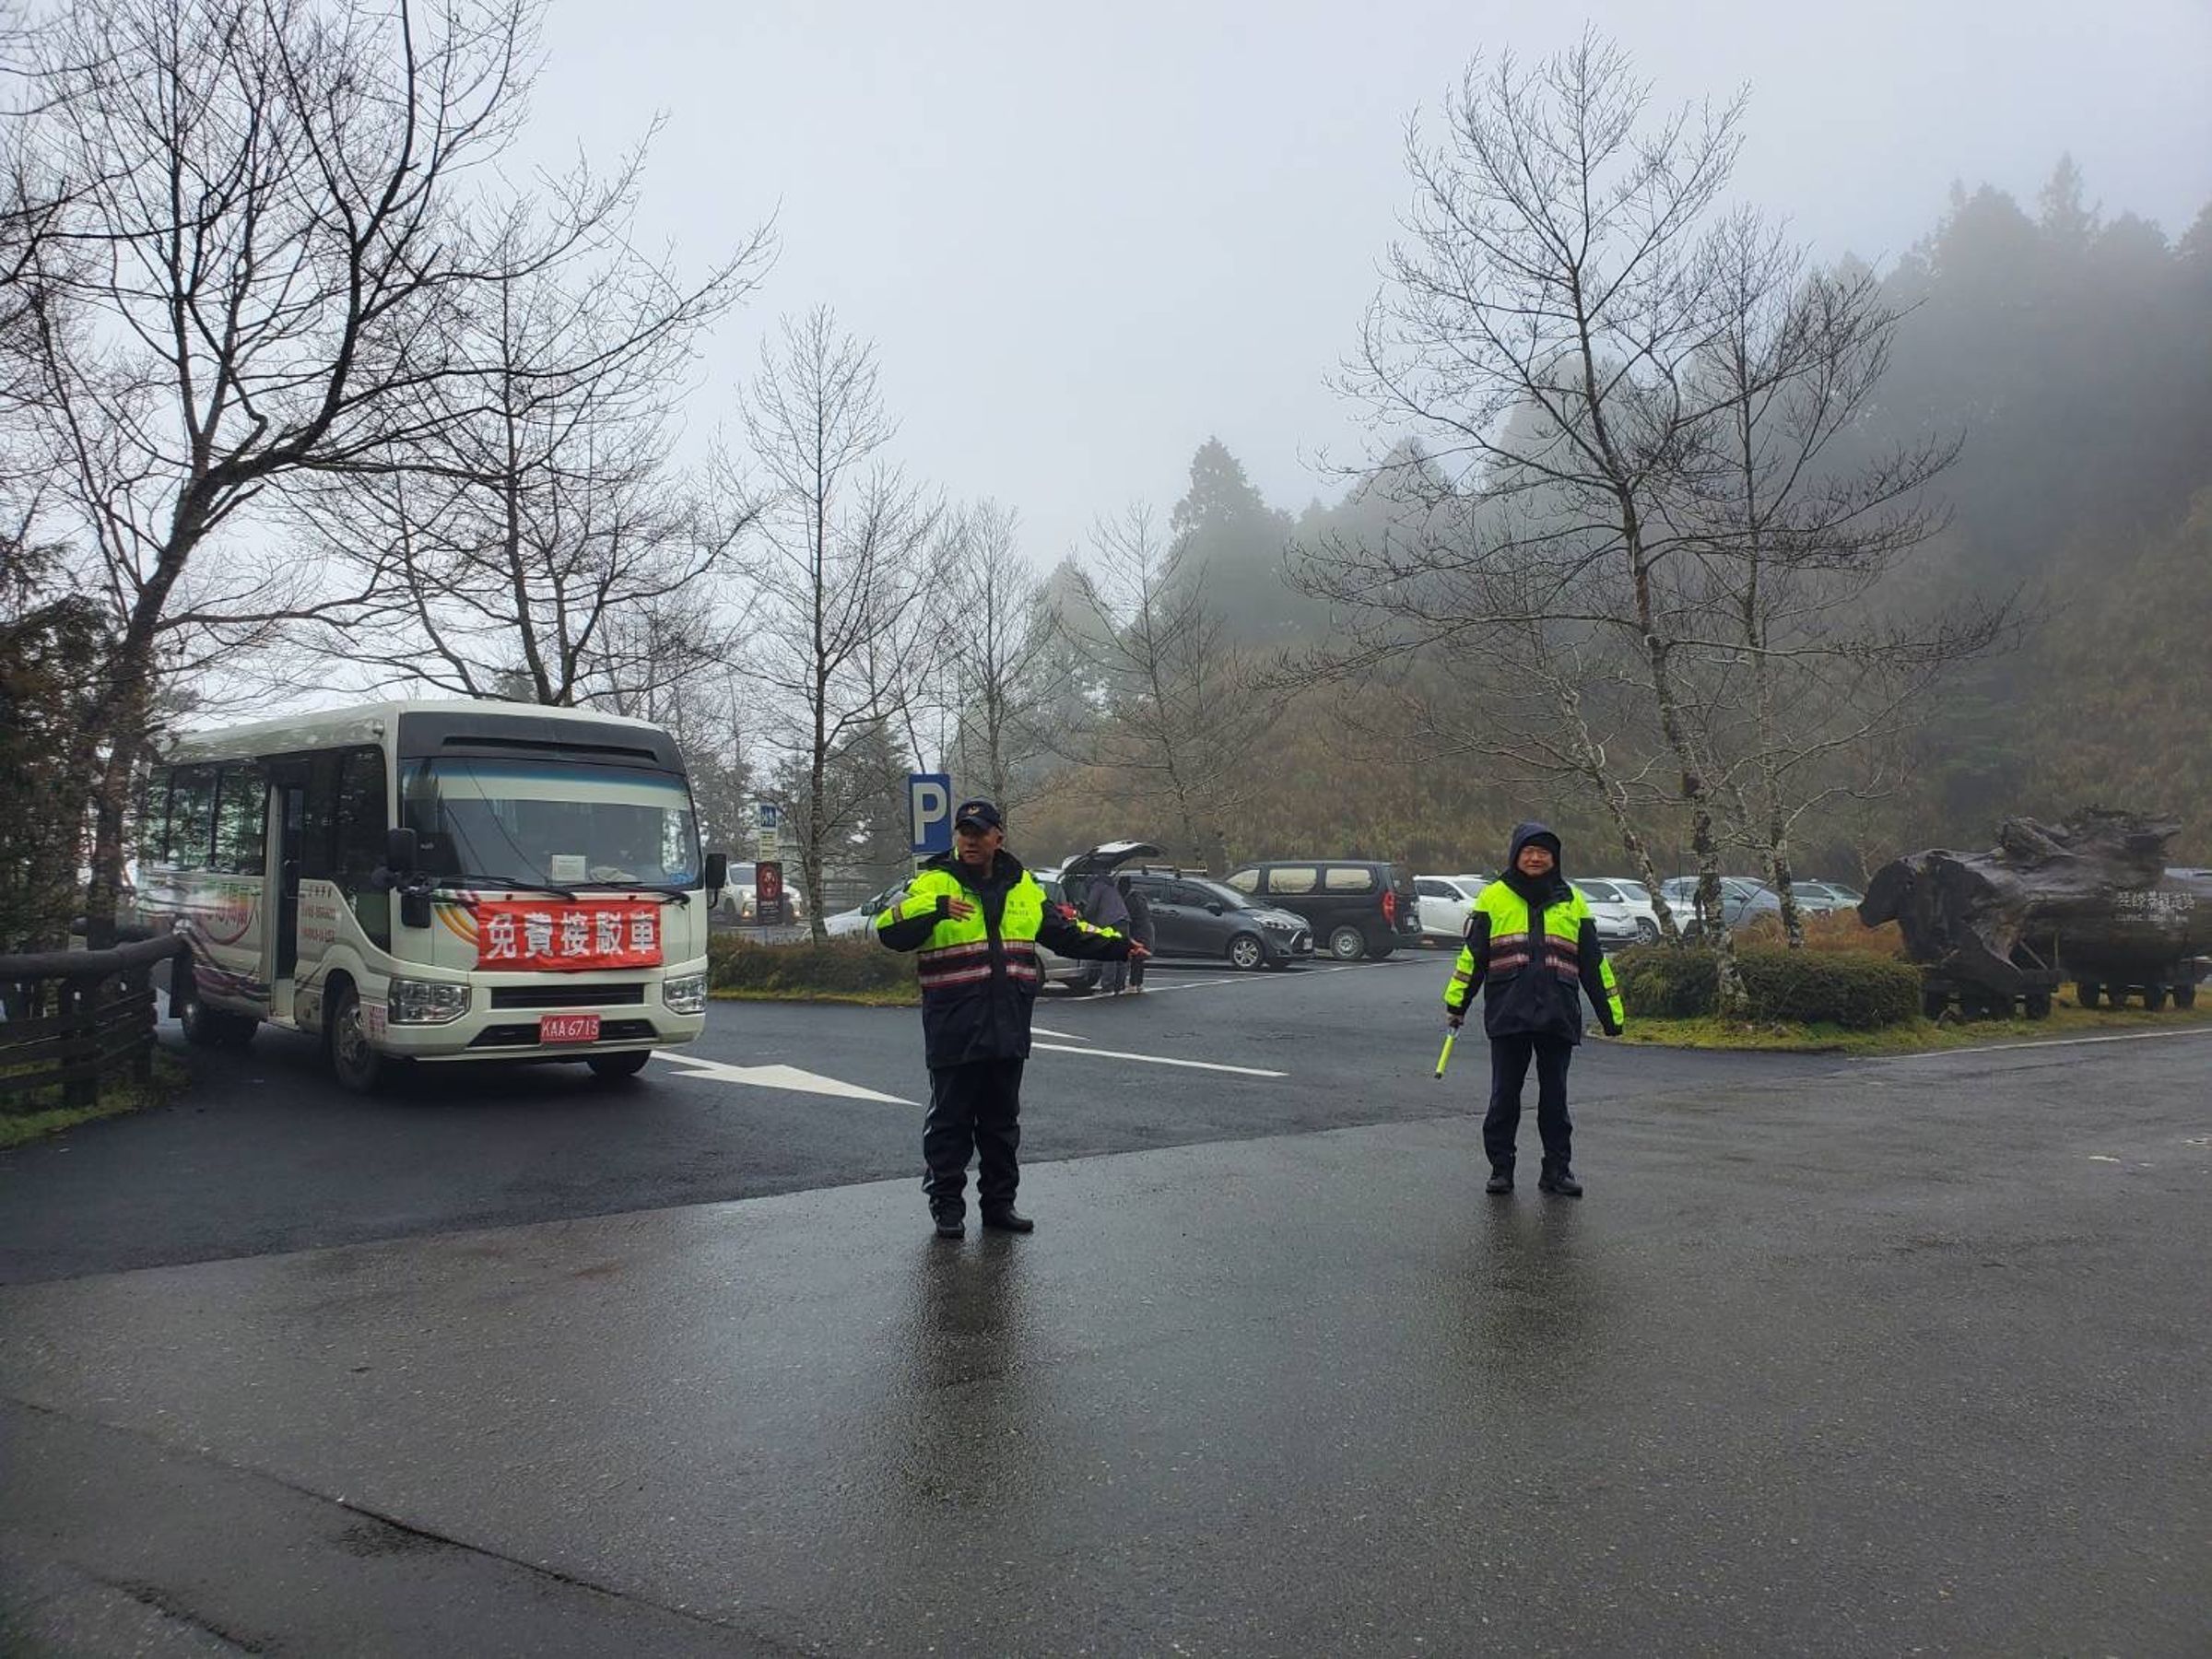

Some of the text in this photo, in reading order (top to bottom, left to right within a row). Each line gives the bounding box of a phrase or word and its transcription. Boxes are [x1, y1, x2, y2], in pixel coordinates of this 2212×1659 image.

[912, 783, 947, 845] P
[487, 911, 655, 959] 免費接駁車
